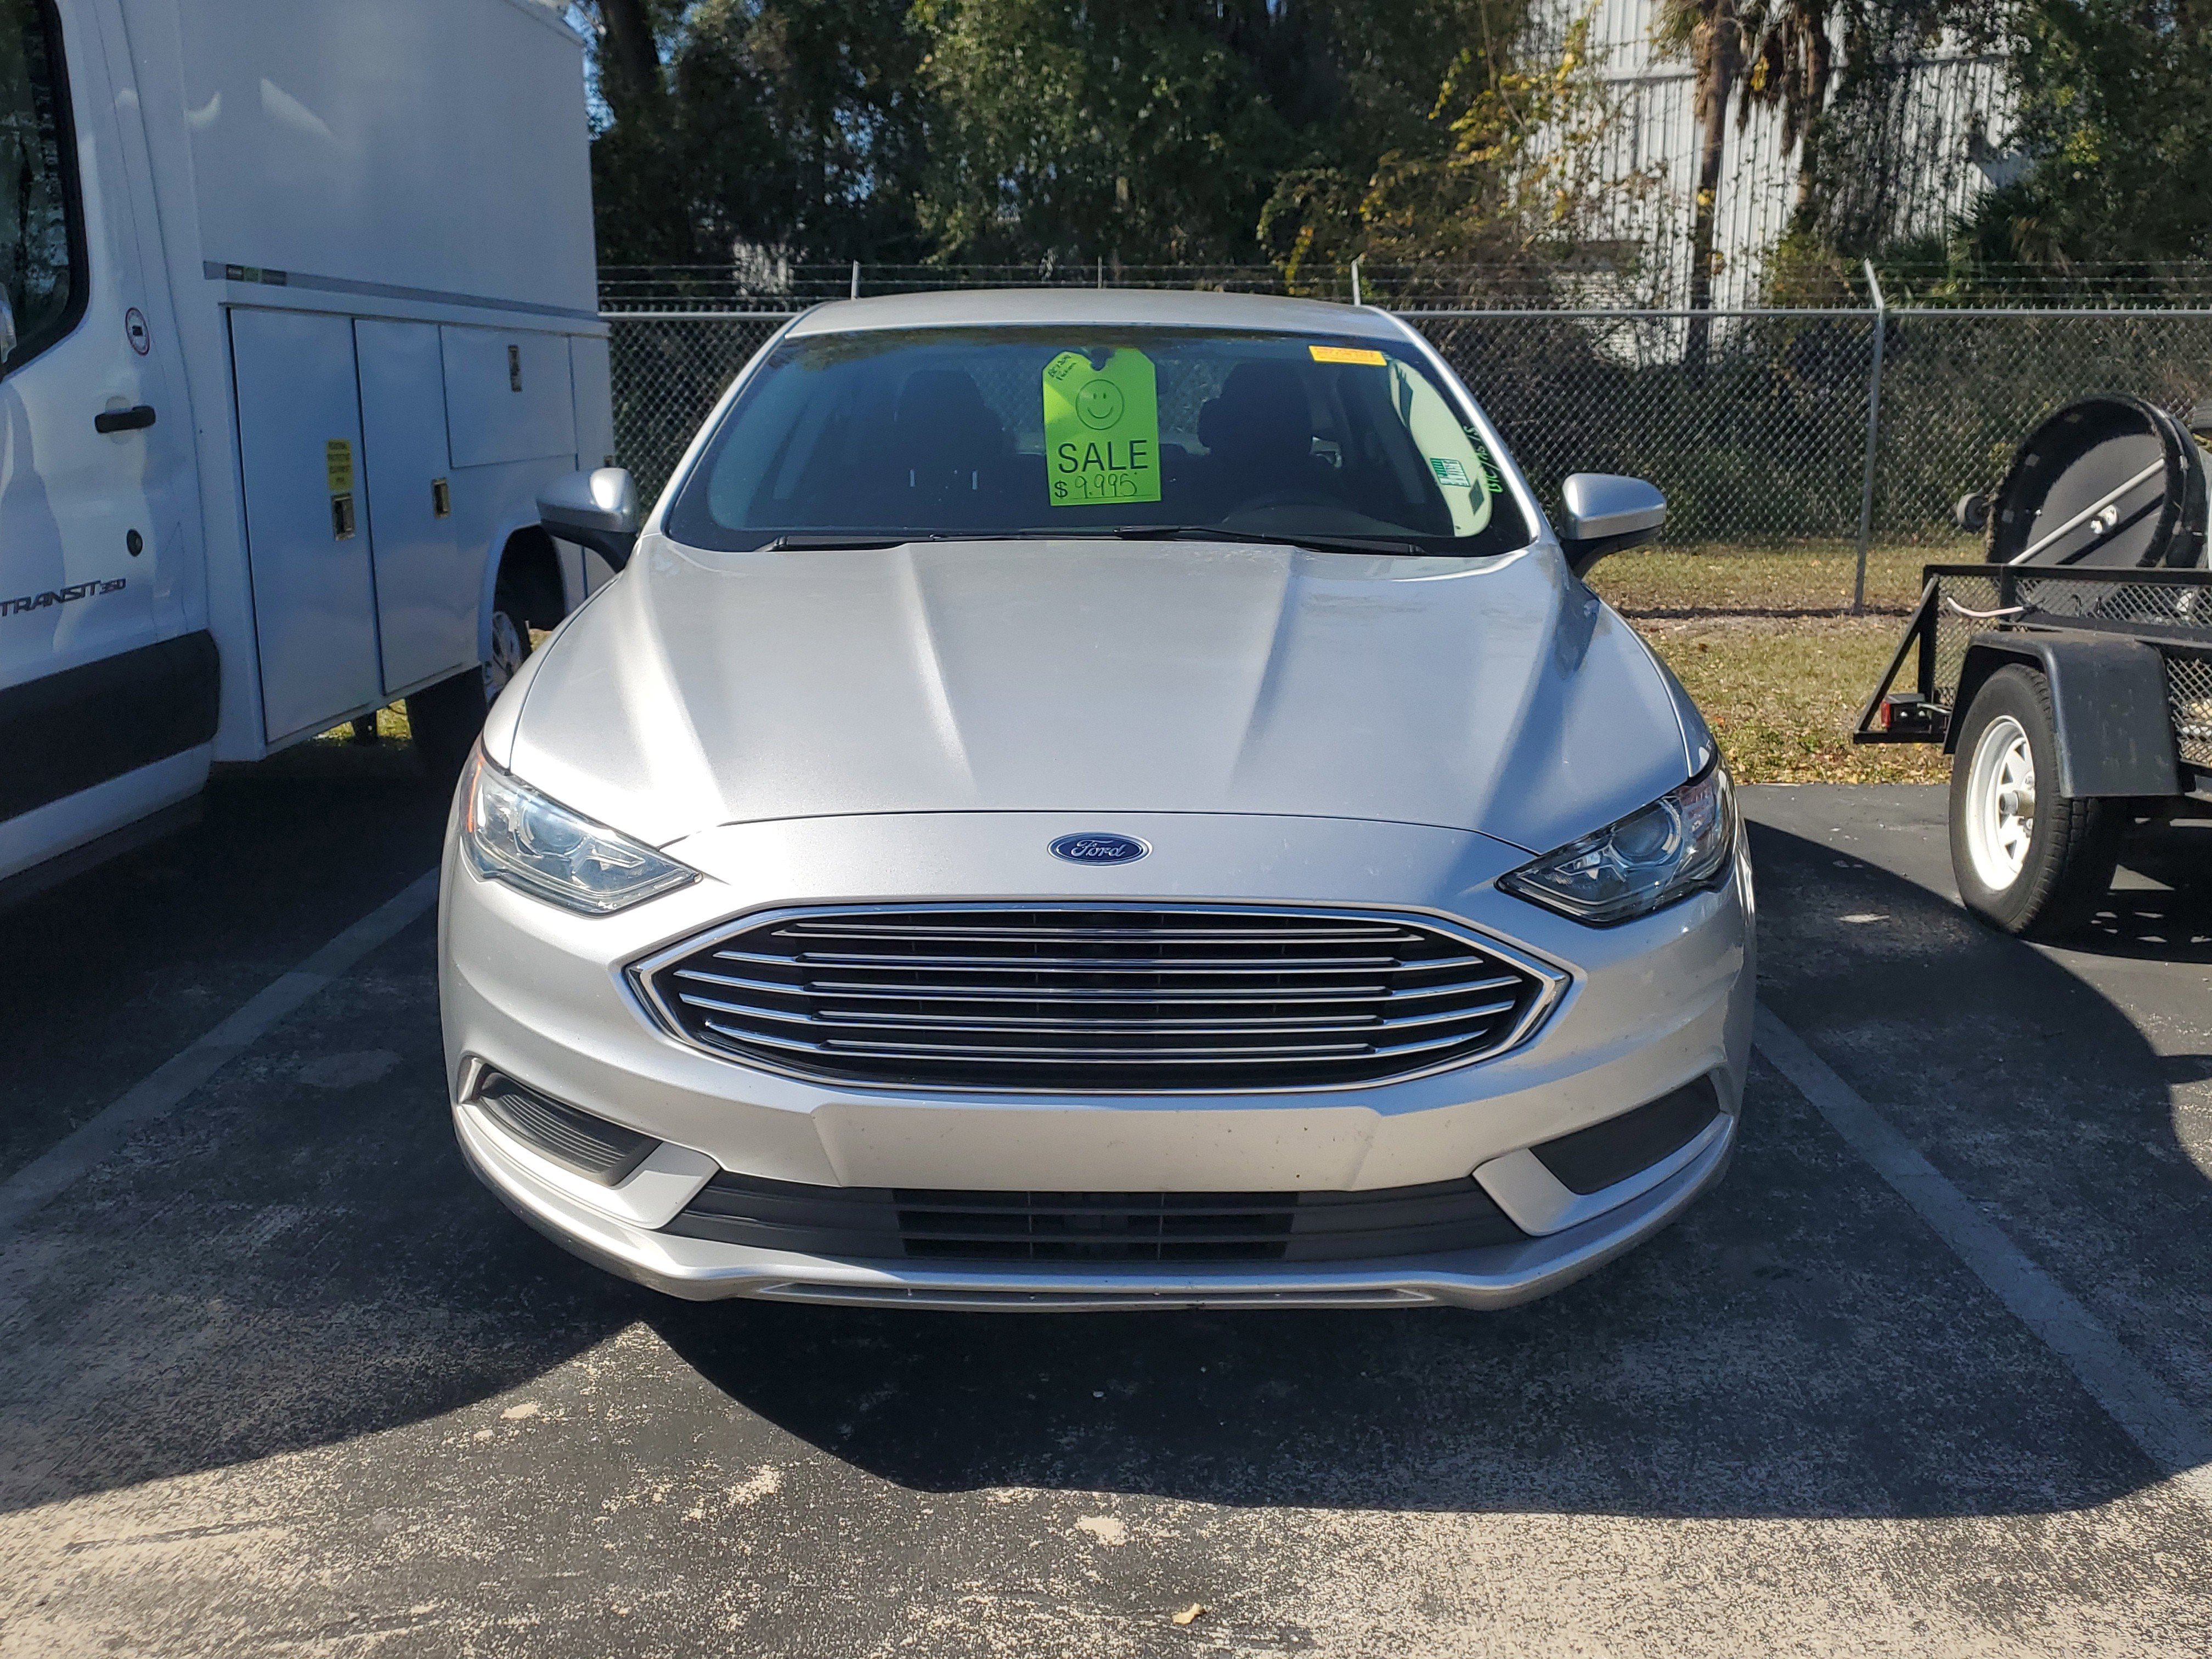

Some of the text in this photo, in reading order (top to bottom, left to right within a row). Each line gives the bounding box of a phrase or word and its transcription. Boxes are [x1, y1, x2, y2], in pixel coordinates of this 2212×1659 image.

[1057, 439, 1148, 473] SALE
[0, 579, 101, 617] TRANSIT
[1071, 839, 1127, 857] Ford
